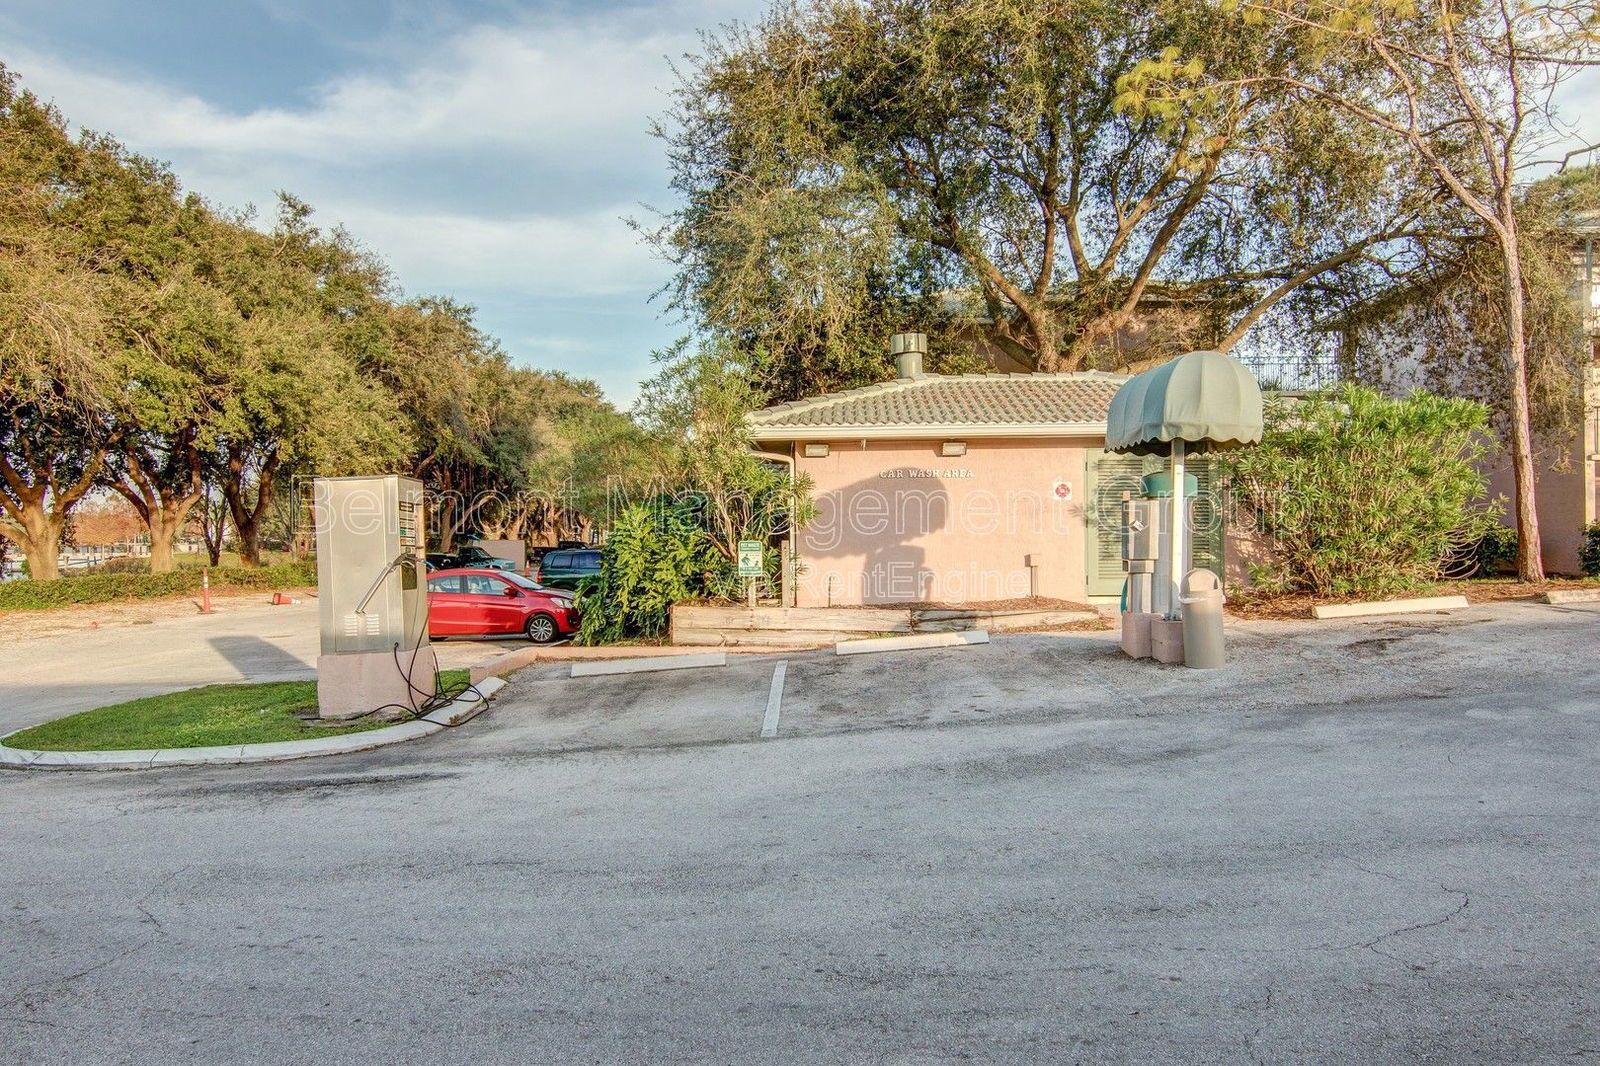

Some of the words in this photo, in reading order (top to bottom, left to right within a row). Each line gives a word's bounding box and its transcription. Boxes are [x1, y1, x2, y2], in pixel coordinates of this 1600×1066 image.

[880, 469, 904, 478] CAR
[908, 469, 940, 478] WASH
[943, 469, 975, 478] AREA
